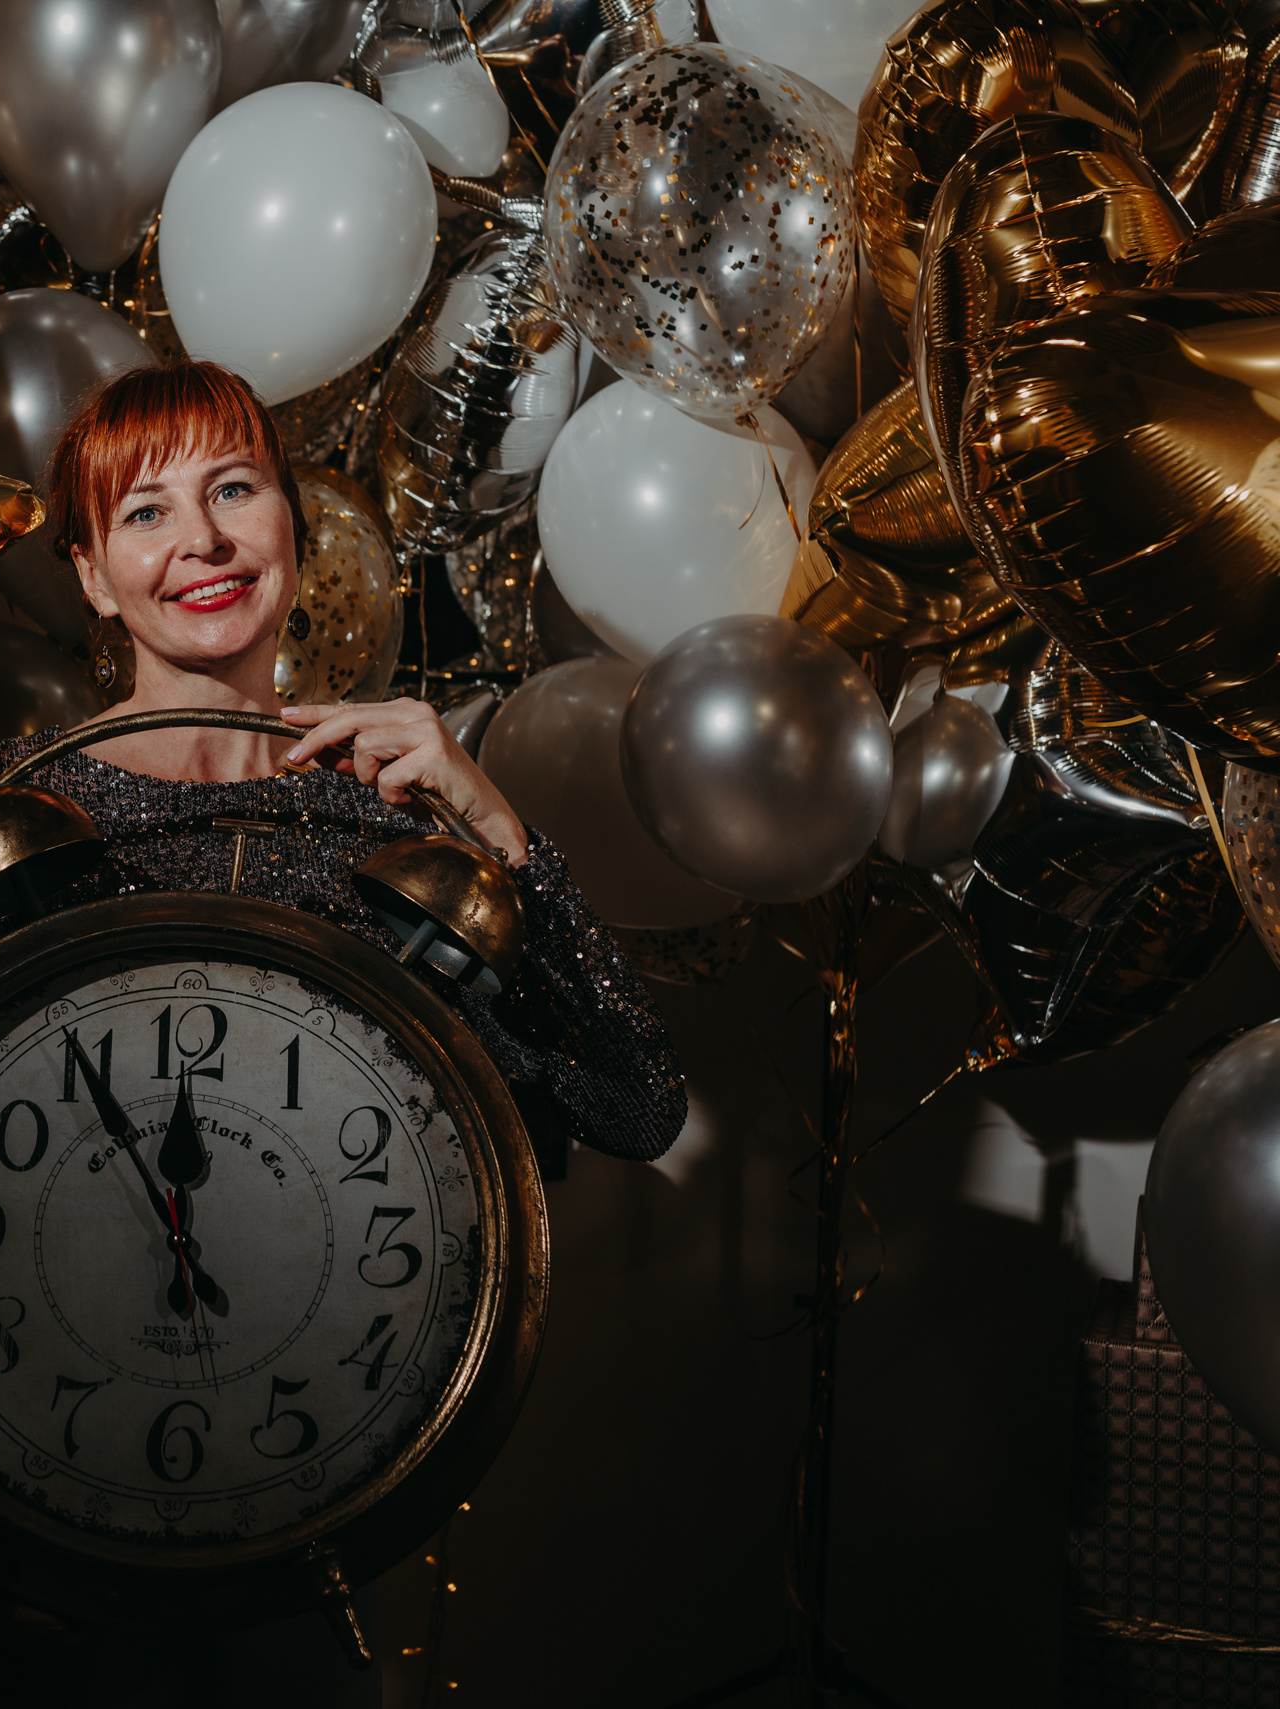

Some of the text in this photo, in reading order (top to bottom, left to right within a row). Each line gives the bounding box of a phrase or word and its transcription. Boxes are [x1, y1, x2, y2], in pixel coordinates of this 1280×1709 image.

[52, 1002, 70, 1020] 55
[182, 978, 202, 990] 60
[312, 1015, 324, 1026] 5
[57, 1027, 113, 1103] 11
[150, 1003, 228, 1083] 12
[280, 1034, 303, 1110] 1
[338, 1105, 392, 1186] 2
[357, 1205, 423, 1289] 3
[338, 1313, 400, 1391] 4
[401, 1369, 418, 1391] 20
[50, 1374, 115, 1460] 7
[145, 1400, 212, 1484] 6
[250, 1374, 319, 1460] 5
[300, 1465, 319, 1484] 25
